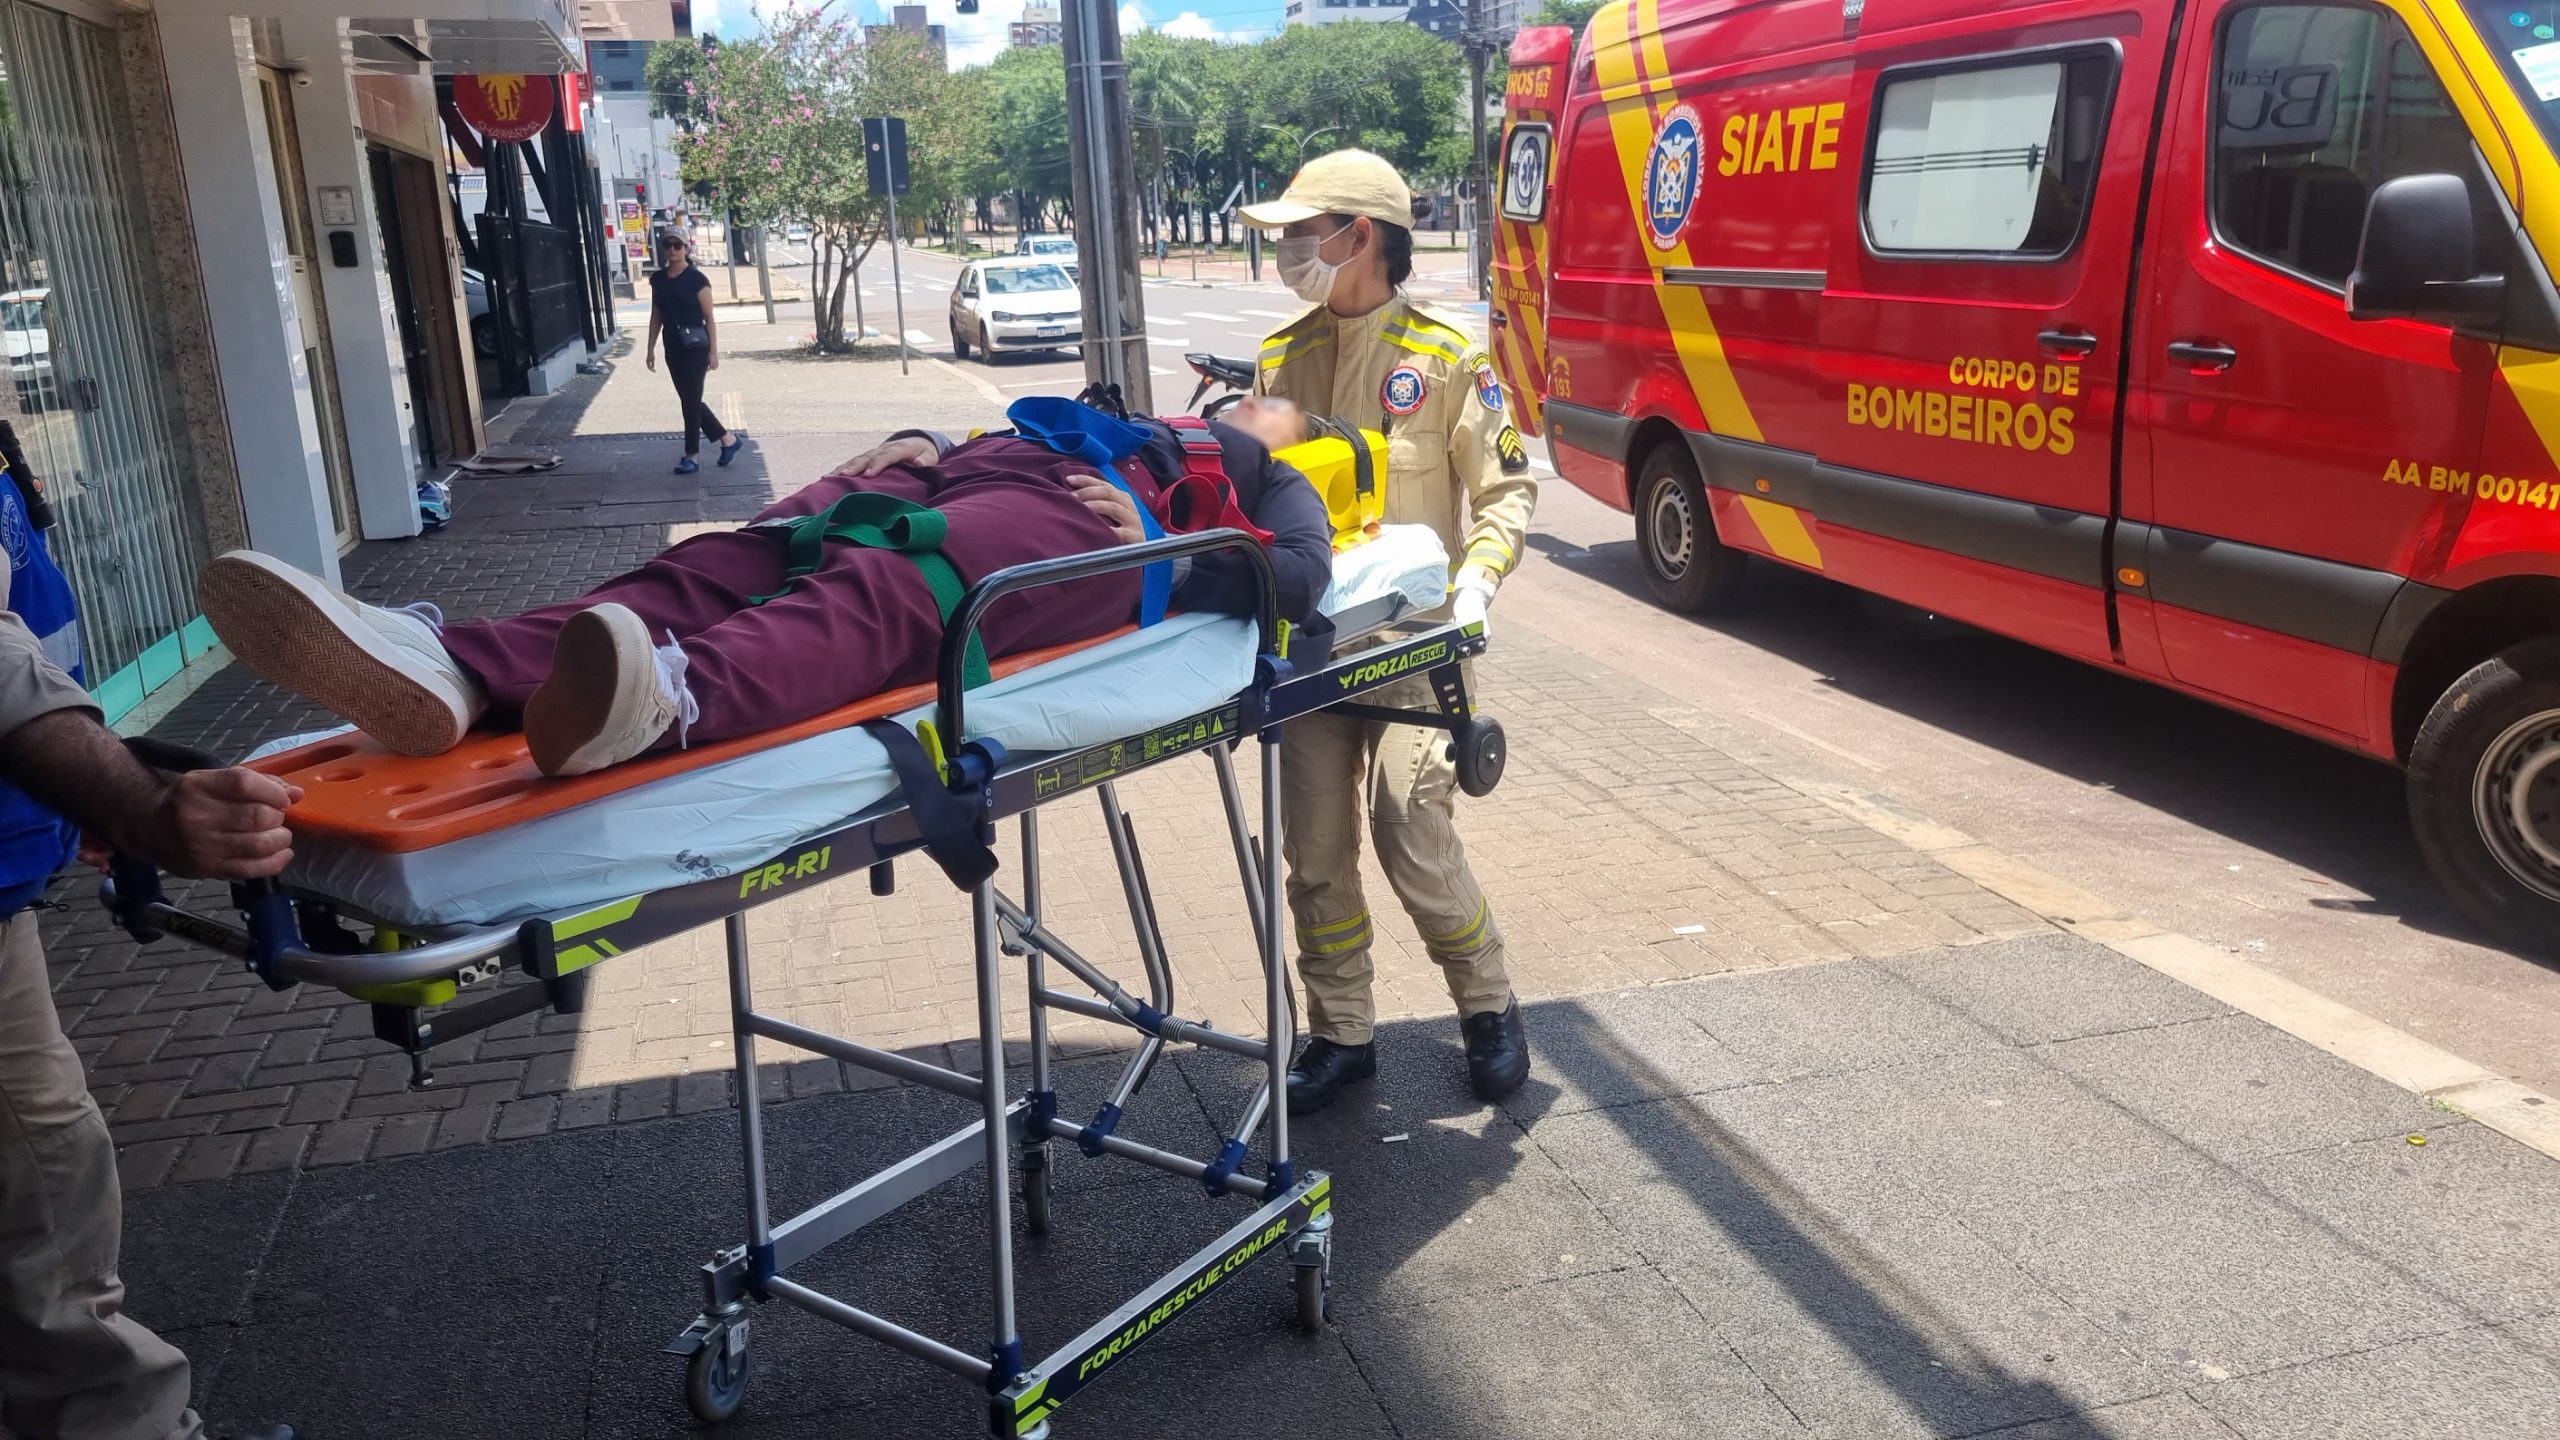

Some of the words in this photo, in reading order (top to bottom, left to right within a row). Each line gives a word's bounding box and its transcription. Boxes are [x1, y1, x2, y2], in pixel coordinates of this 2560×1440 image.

[477, 120, 541, 139] SHAWARMA
[1664, 104, 1702, 133] BOMBEIROS
[1695, 133, 1705, 199] MILITAR
[1717, 102, 1846, 177] SIATE
[1554, 377, 1571, 398] 193
[1949, 356, 2036, 391] CORPO
[2043, 364, 2081, 396] DE
[1847, 383, 2076, 456] BOMBEIROS
[2382, 458, 2422, 488] AA
[2428, 466, 2471, 496] BM
[2476, 473, 2560, 511] 00141
[1353, 653, 1410, 687] FORZA
[1410, 643, 1447, 666] RESCUE
[739, 845, 832, 899] FR-R1
[1079, 1217, 1288, 1381] FORZARESCUE.COM.BR
